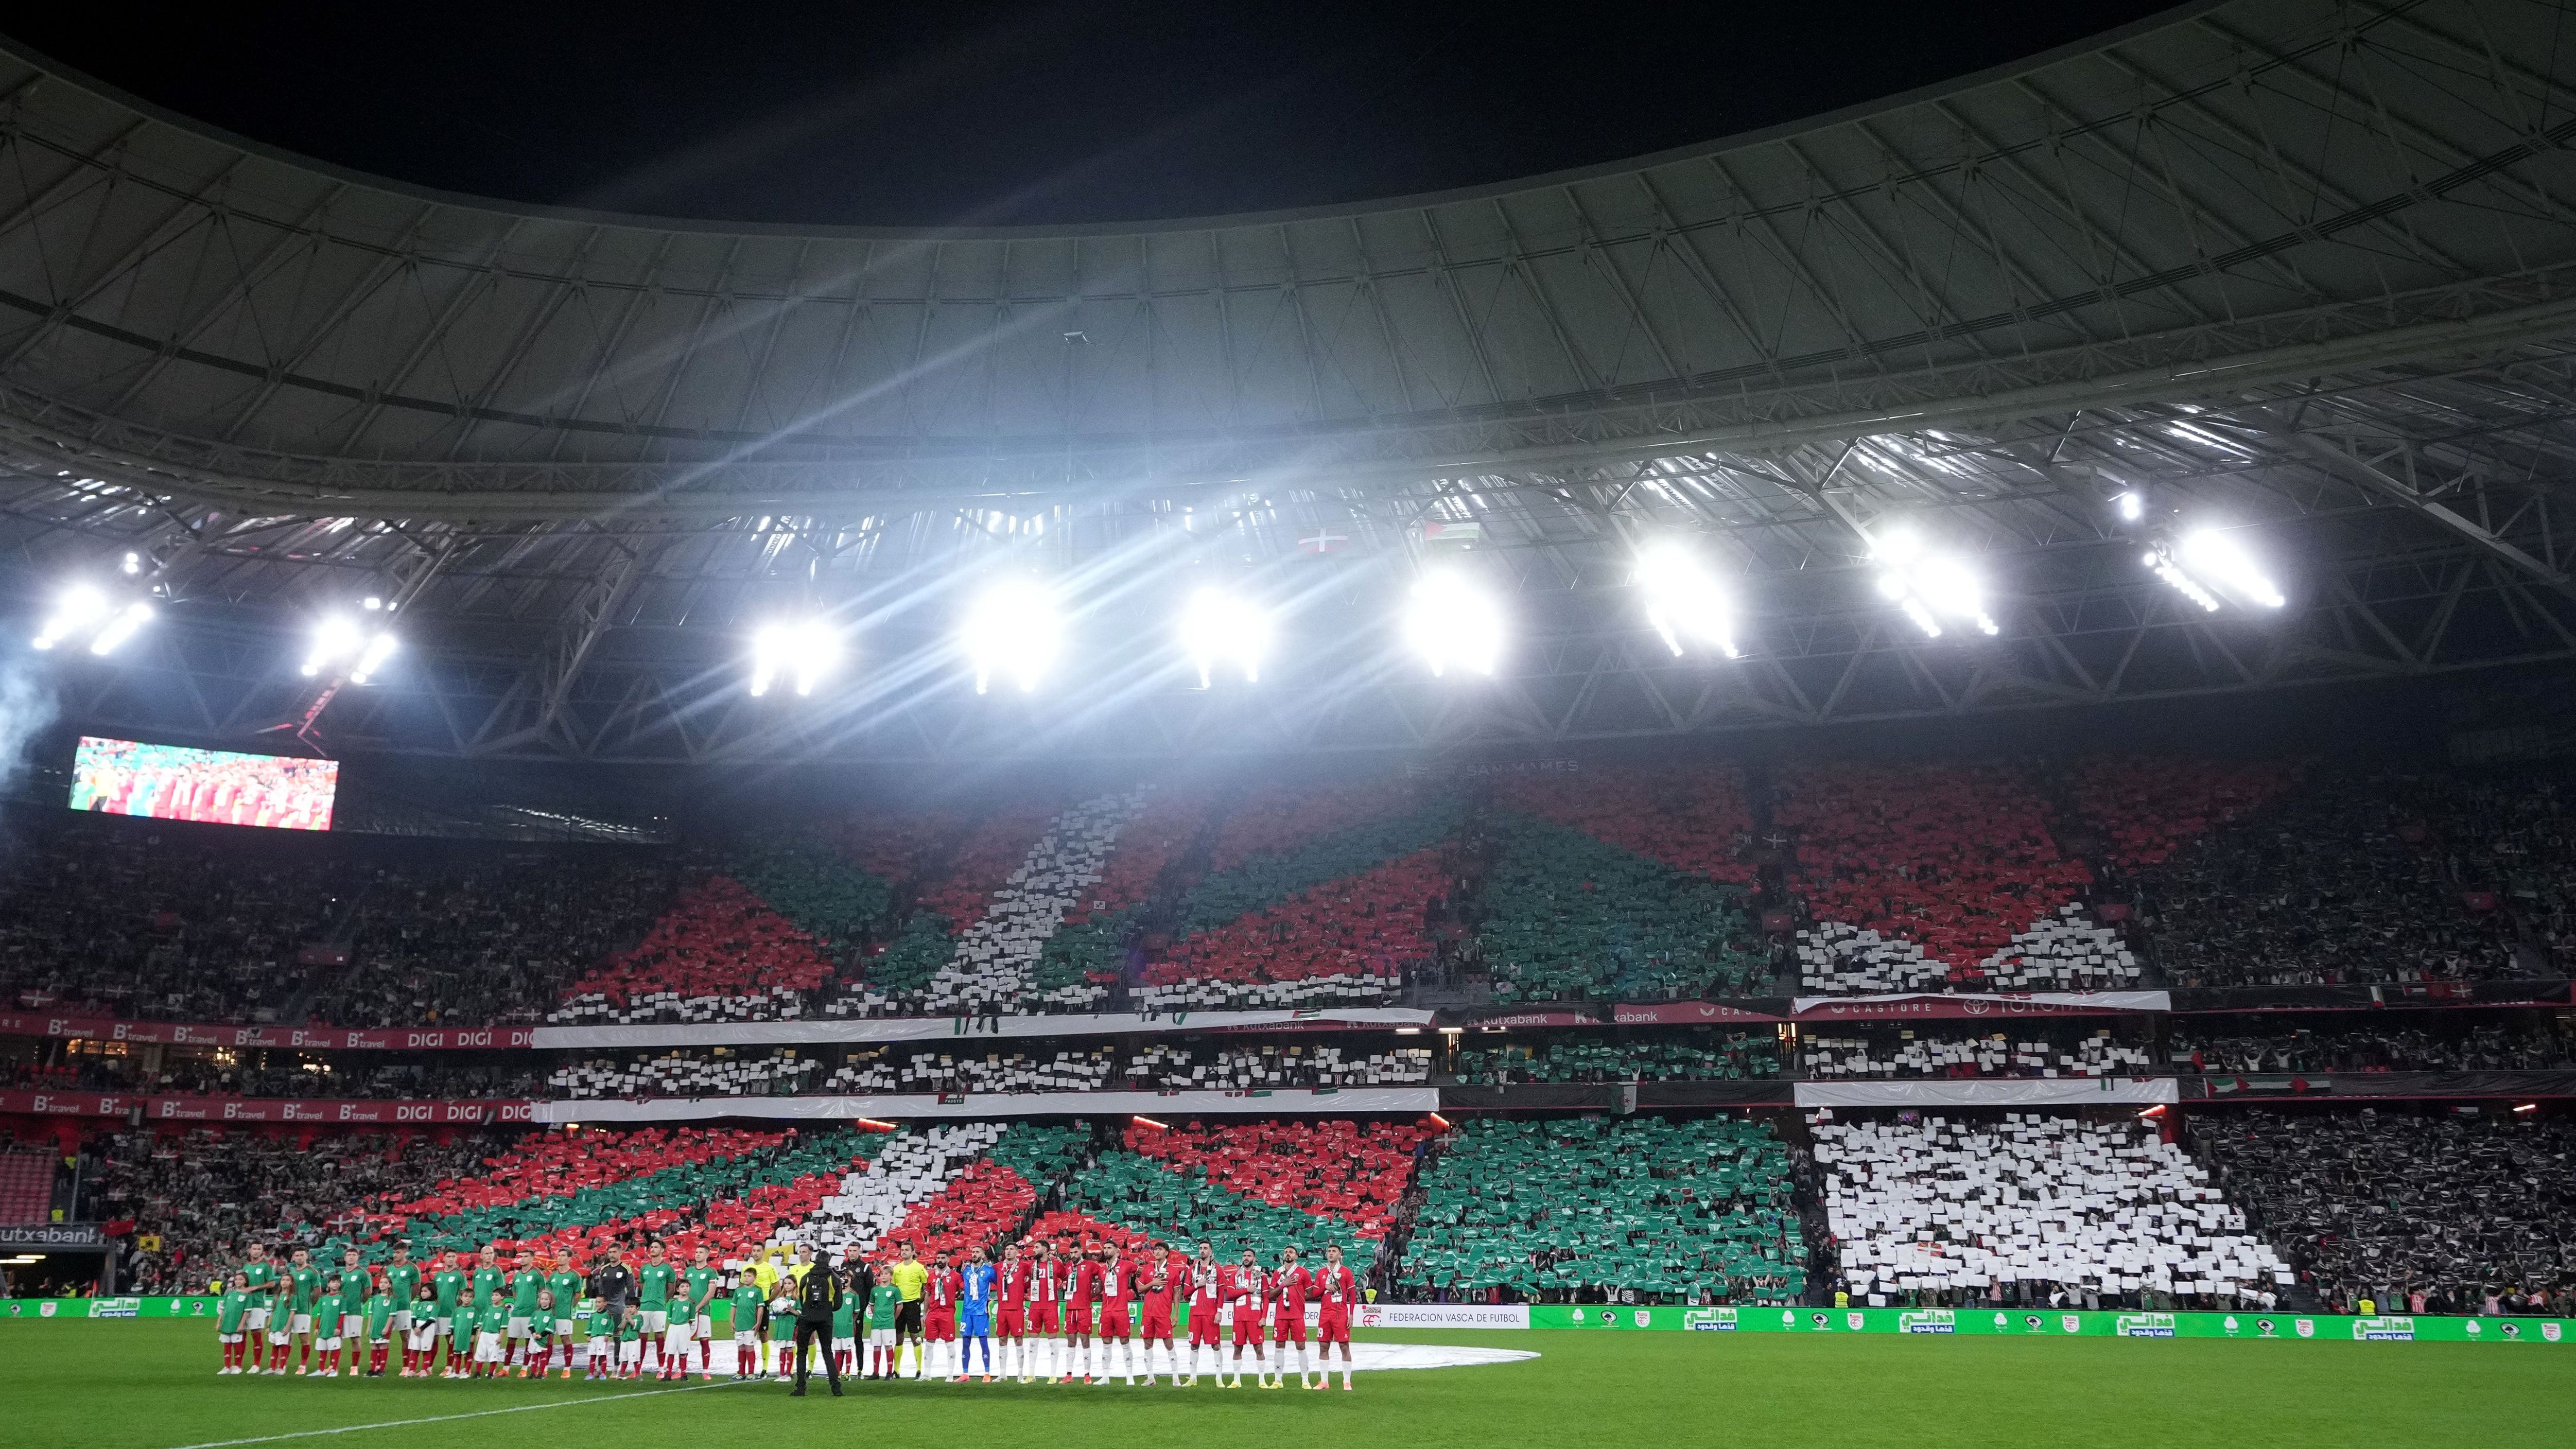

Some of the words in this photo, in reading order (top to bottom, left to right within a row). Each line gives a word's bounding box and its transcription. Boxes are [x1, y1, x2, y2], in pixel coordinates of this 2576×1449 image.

[1853, 1003, 1931, 1012] CASTORE
[1483, 1014, 1547, 1025] kutxabank
[408, 1033, 443, 1047] DIGI
[458, 1032, 492, 1046] DIGI
[115, 1107, 129, 1115] tra
[396, 1106, 432, 1120] DIGI
[447, 1106, 481, 1120] DIGI
[502, 1106, 530, 1119] DIG
[1, 1228, 96, 1243] utxabank
[1389, 1313, 1442, 1322] FEDERACION
[1446, 1314, 1474, 1322] VASCA
[1477, 1314, 1487, 1322] DE
[1490, 1314, 1520, 1322] FUTBOL
[1273, 1327, 1278, 1338] 5
